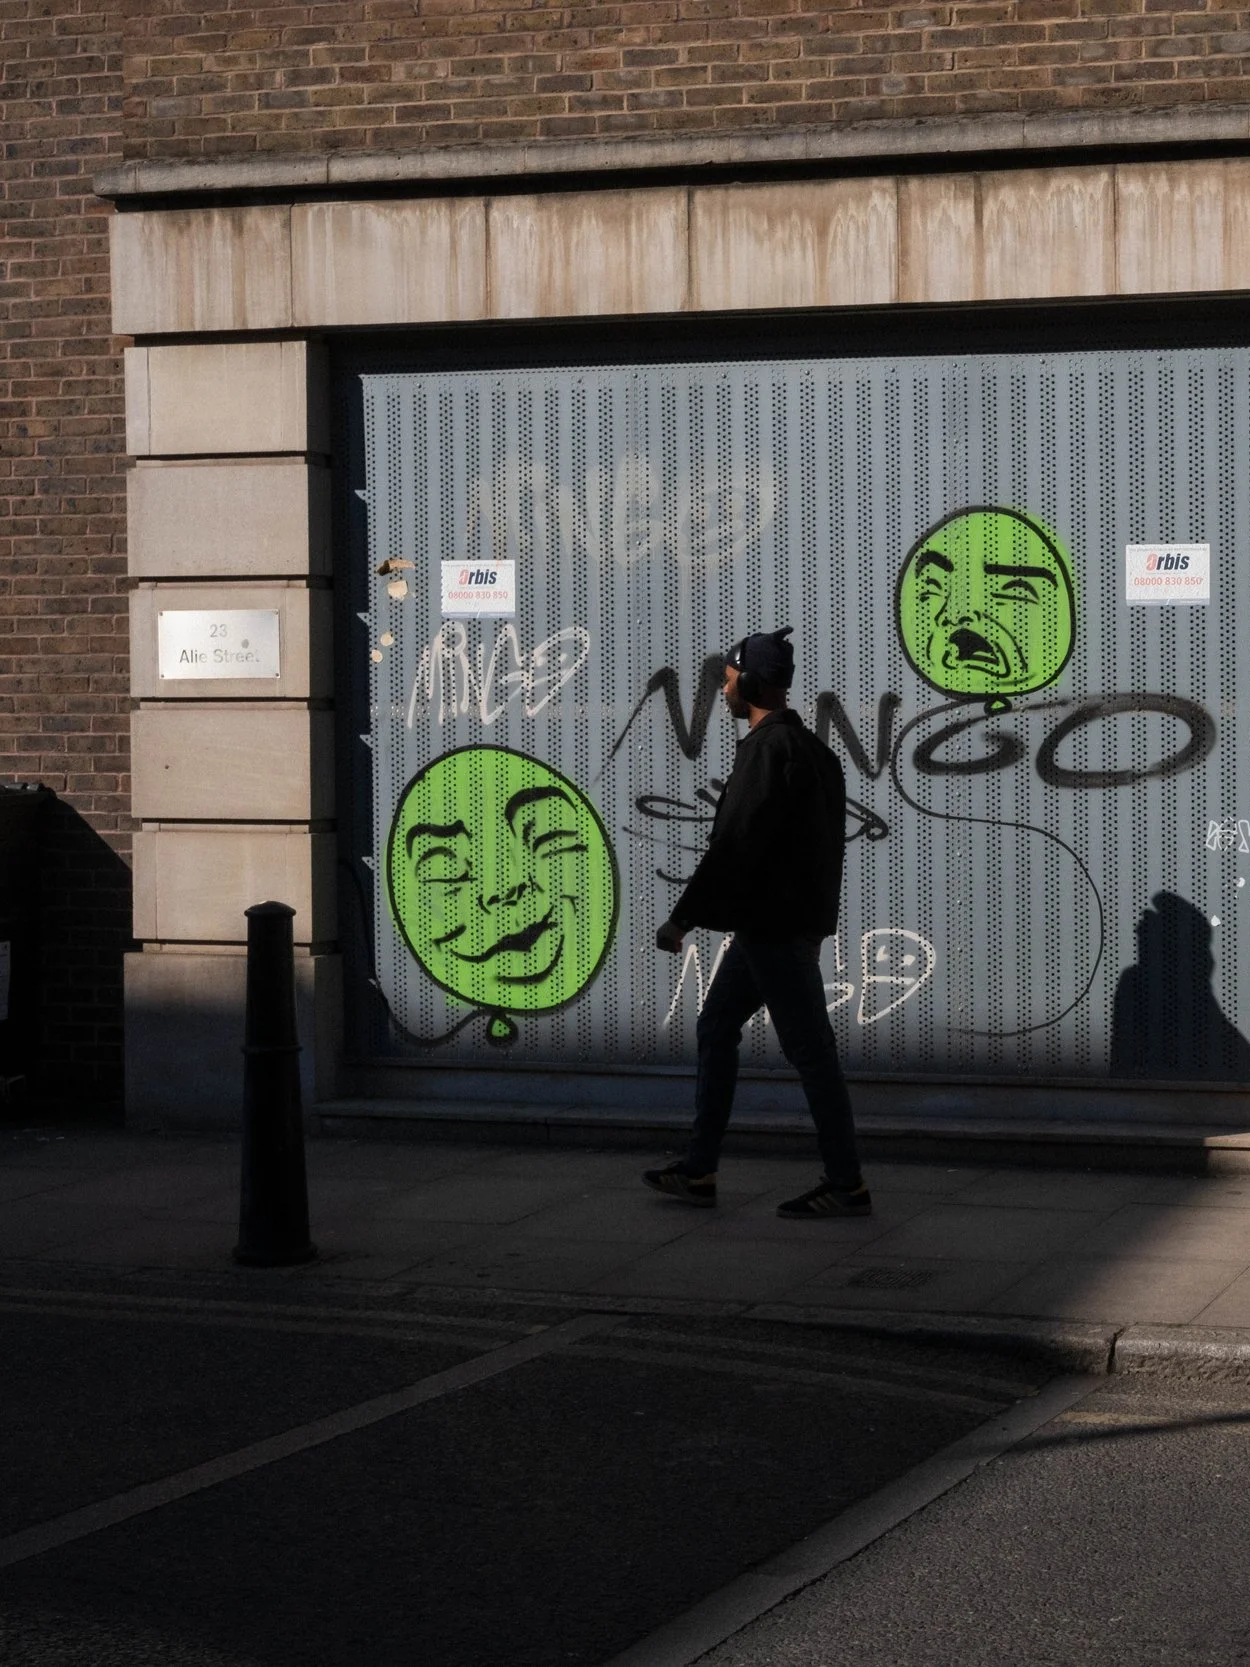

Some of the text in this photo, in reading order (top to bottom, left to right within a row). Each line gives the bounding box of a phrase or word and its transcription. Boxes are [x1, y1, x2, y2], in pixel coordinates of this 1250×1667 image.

[1146, 553, 1190, 571] Orbis
[458, 568, 498, 585] Orbis
[1134, 576, 1202, 586] 08000 830 850
[448, 591, 509, 600] 08000 830 850
[209, 623, 228, 638] 23
[179, 649, 208, 664] Alie
